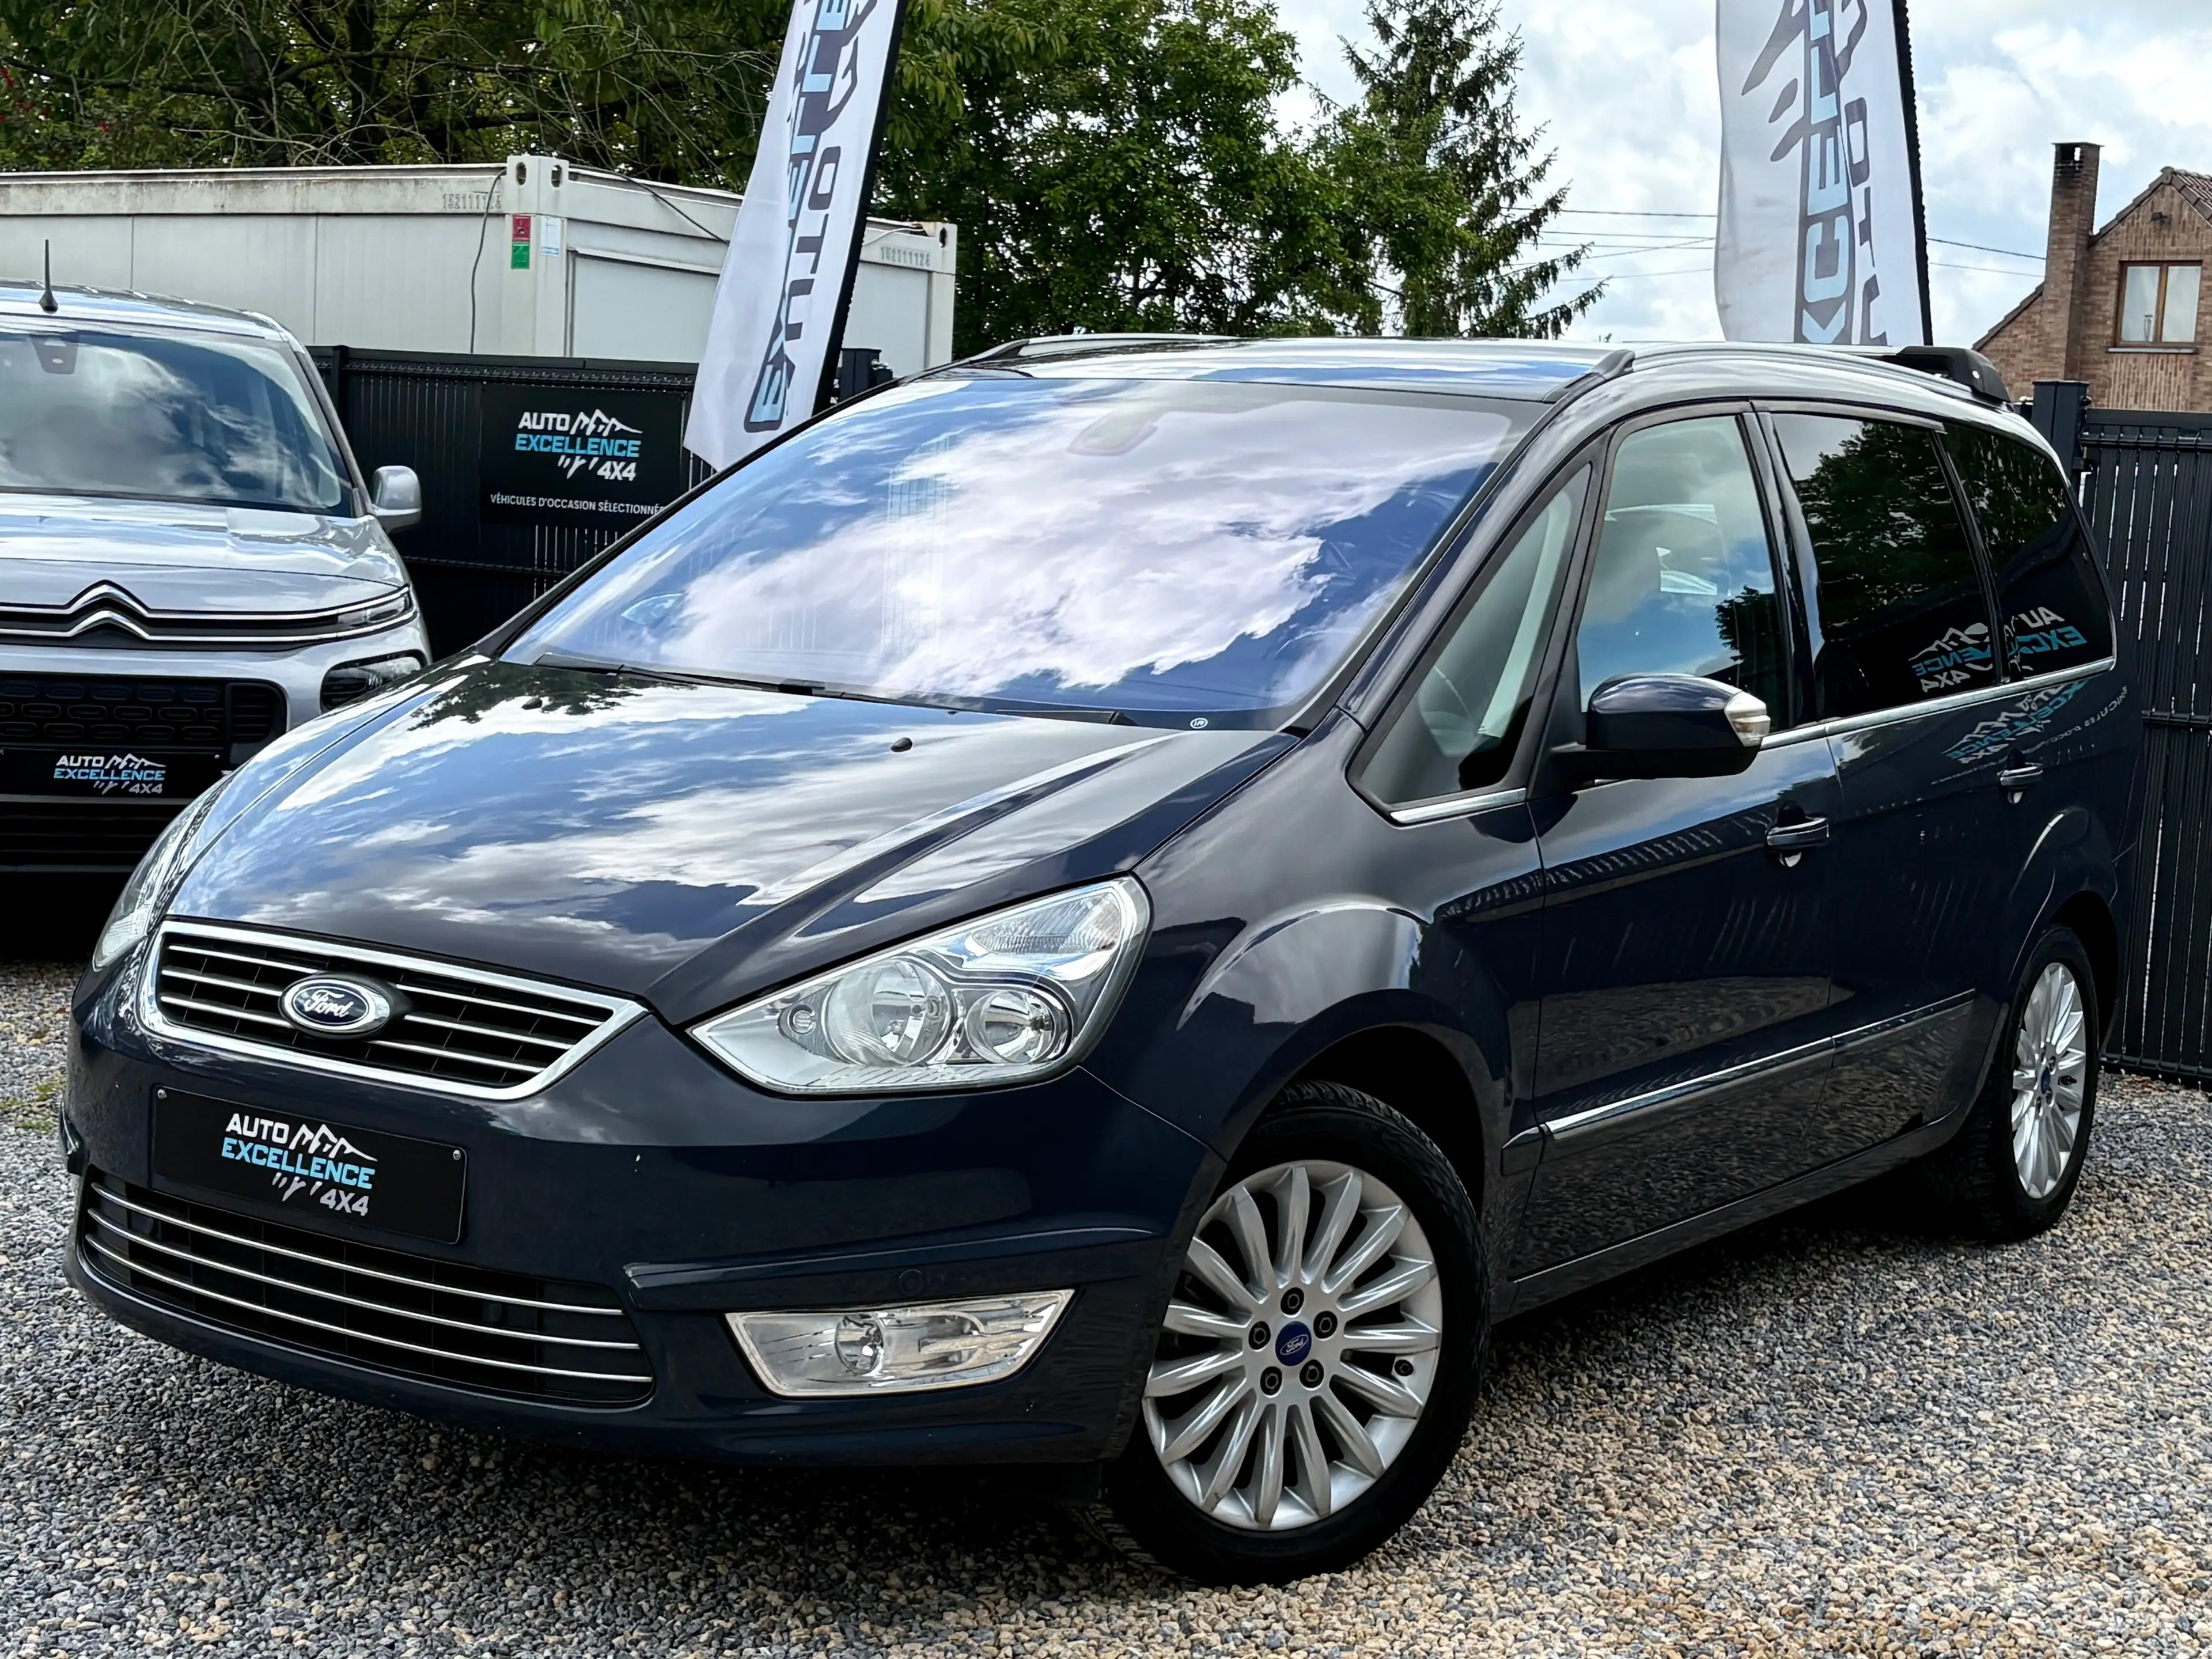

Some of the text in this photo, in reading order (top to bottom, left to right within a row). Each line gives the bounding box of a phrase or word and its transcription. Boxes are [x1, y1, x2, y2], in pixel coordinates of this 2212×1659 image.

[518, 412, 570, 431] AUTO
[515, 433, 642, 457] EXCELLENCE
[597, 461, 637, 481] 4X4
[490, 492, 536, 507] VÉHICULES
[539, 497, 596, 510] D'OCCASION
[56, 755, 105, 767] AUTO
[54, 768, 166, 781] EXCELLENCE
[128, 783, 162, 794] 4X4
[303, 989, 354, 1018] Ford
[225, 1113, 290, 1144] AUTO
[221, 1137, 375, 1189] EXCELLENCE
[320, 1188, 369, 1216] 4X4
[1285, 1337, 1305, 1354] Ford
